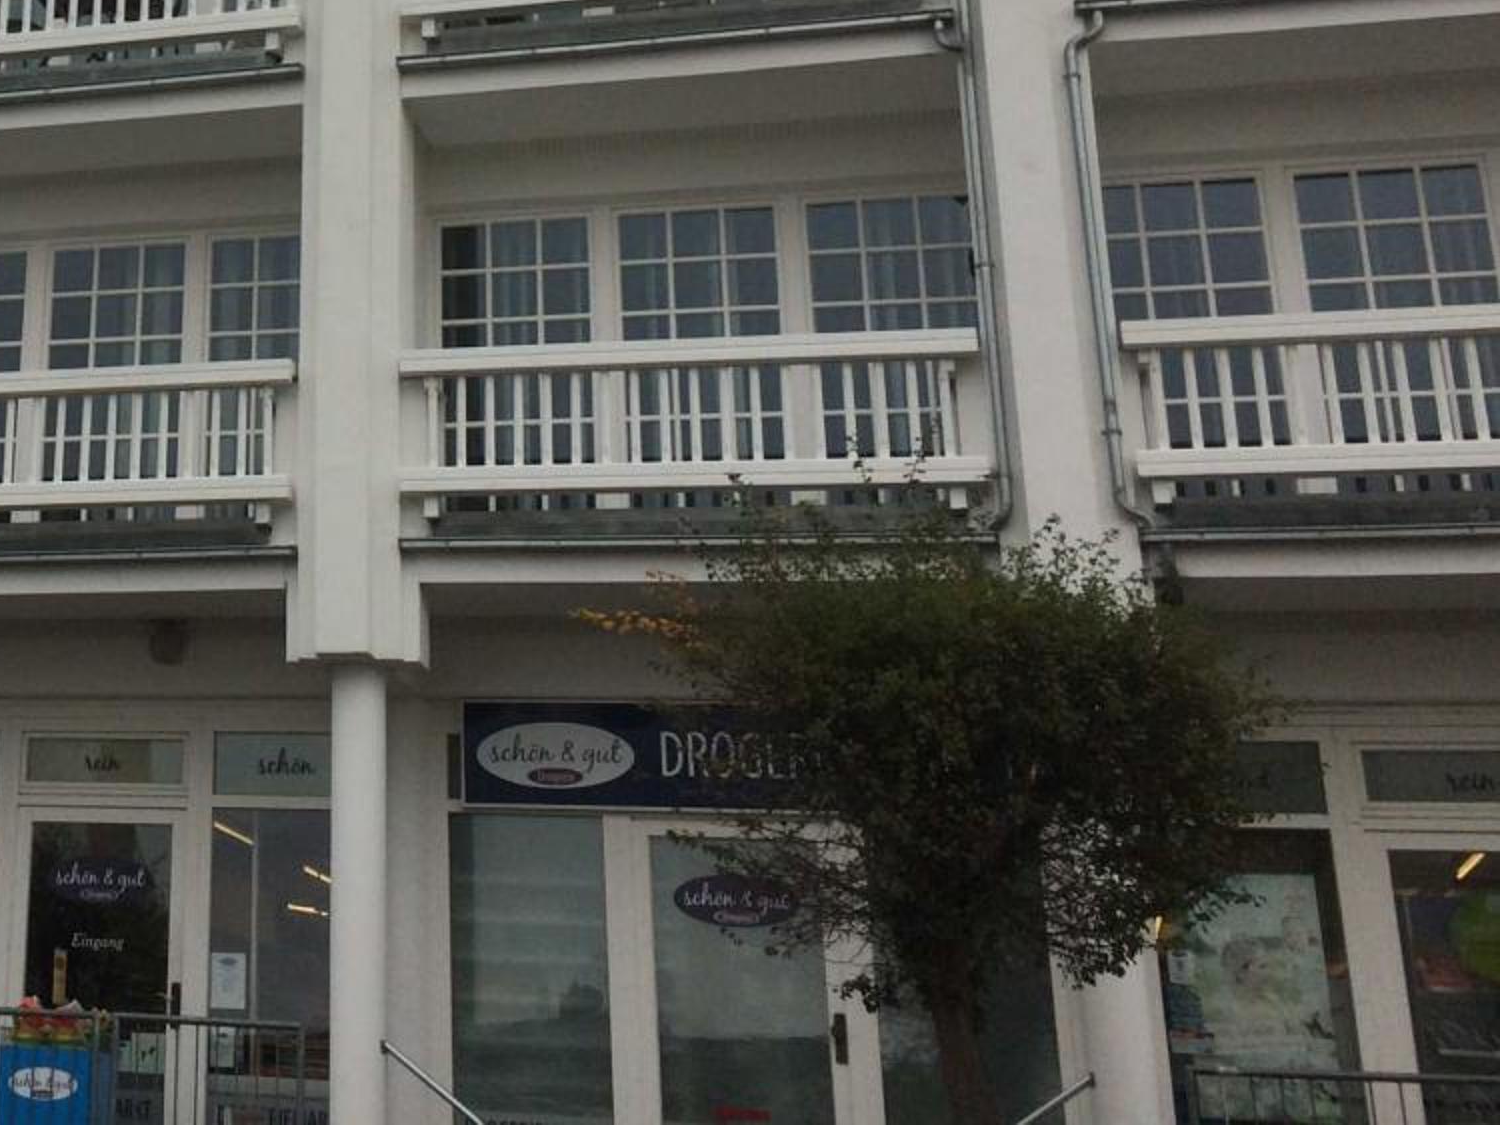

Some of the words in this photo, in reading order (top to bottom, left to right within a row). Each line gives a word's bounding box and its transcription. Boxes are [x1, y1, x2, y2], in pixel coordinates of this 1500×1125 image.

[84, 749, 121, 773] rein
[561, 739, 575, 763] &
[581, 738, 622, 774] gut
[103, 867, 114, 885] &
[117, 867, 147, 894] gut
[71, 931, 125, 953] Eingang
